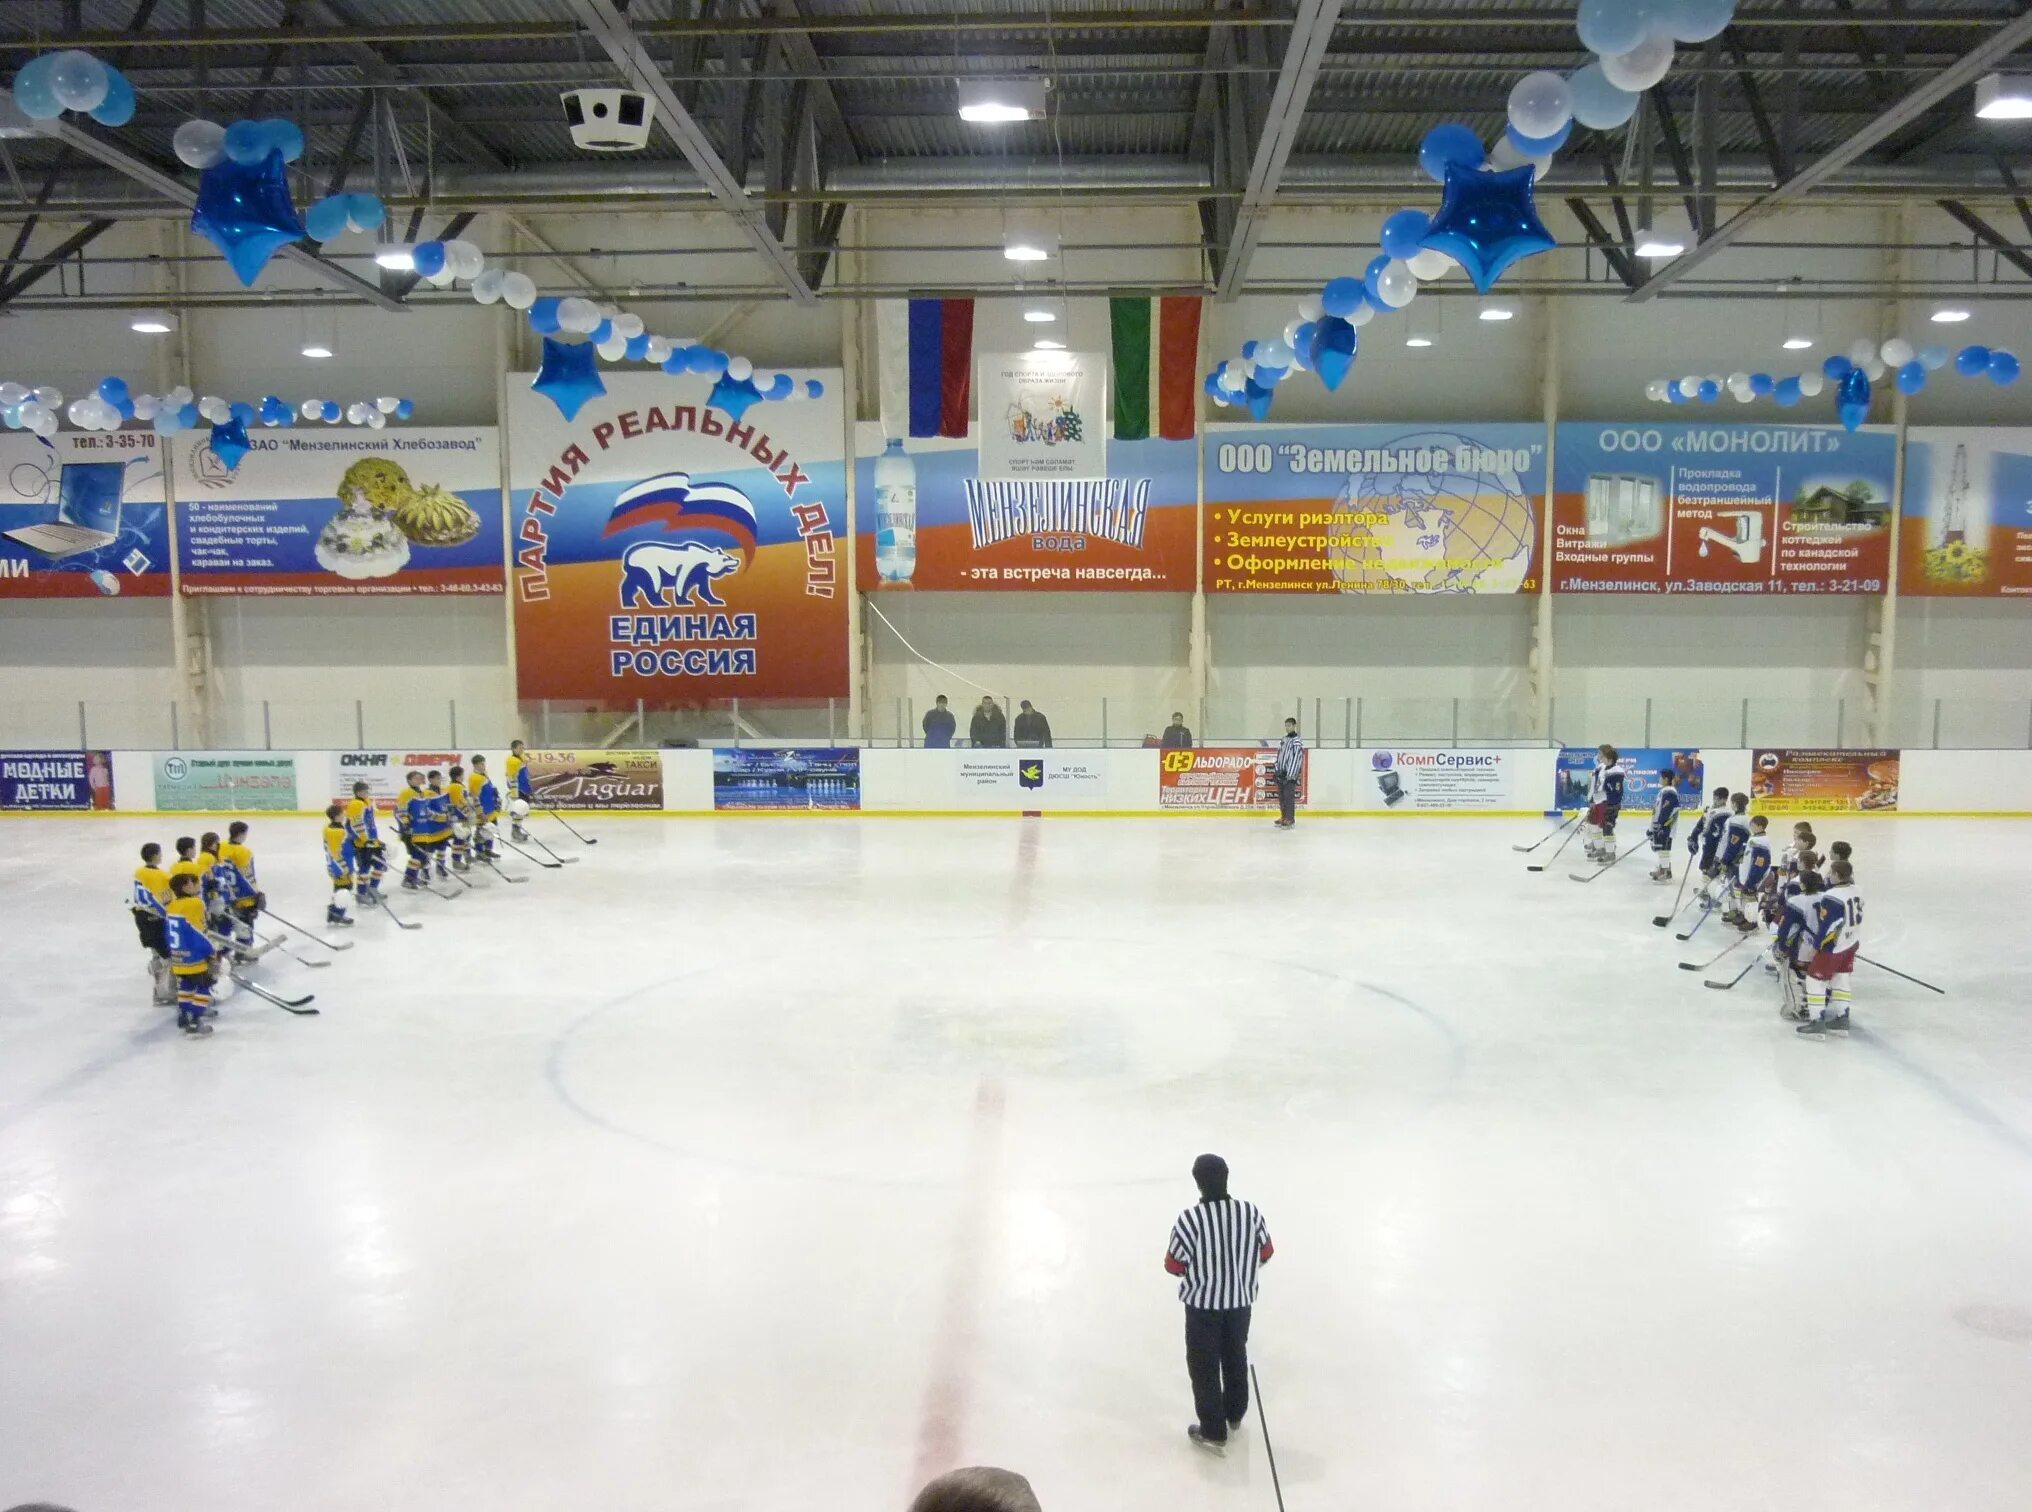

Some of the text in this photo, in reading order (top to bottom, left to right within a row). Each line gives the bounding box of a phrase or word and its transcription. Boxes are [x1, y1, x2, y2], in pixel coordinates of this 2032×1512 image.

[73, 434, 156, 449] тел.: 3-35-70
[250, 438, 280, 452] ЗАО
[1599, 430, 1840, 453] ООО «МОНОЛИТ»
[592, 405, 811, 498] РЕАЛЬНЫХ
[1218, 444, 1273, 474] ООО
[1679, 467, 1742, 482] Прокладка
[1678, 482, 1757, 493] водопровода
[188, 502, 200, 512] 50
[207, 502, 279, 512] наименований
[1677, 494, 1772, 506] безтраншейный
[189, 513, 265, 524] хлебобулочных
[963, 478, 1153, 551] МЕНЗЕЛИНСКАЯ
[1228, 508, 1390, 528] Услуги риэлтора
[1677, 508, 1713, 519] метод
[519, 443, 591, 603] ПАРТИЯ
[1782, 521, 1872, 533] Строительство
[198, 526, 265, 537] кондитерских
[266, 525, 310, 534] изделий,
[1556, 525, 1586, 536] Окна
[190, 537, 279, 546] свадебные торты,
[1032, 534, 1087, 552] вода
[1556, 538, 1607, 550] Витражи
[1782, 534, 1842, 547] коттеджей
[790, 501, 836, 599] ДЕЛ!
[1781, 547, 1859, 559] по канадской
[232, 559, 244, 567] на
[246, 559, 275, 567] заказ.
[1227, 555, 1356, 571] Оформление
[1555, 551, 1654, 565] Входные группы
[1780, 561, 1847, 573] технологии
[971, 567, 998, 580] эта
[1003, 567, 1071, 583] встреча
[1075, 567, 1166, 583] навсегда...
[182, 584, 236, 594] Приглашаем
[244, 585, 312, 595] сотрудничеству
[314, 585, 356, 595] торговые
[357, 584, 412, 594] организации
[1216, 579, 1235, 591] РТ,
[1238, 578, 1314, 590] г.Мензелинск
[1315, 578, 1373, 590] ул.Ленина
[1560, 579, 1880, 594] г.Мензелинск, ул.Заводская 11, тел.: 3-21-09
[609, 613, 757, 646] ЕДИНАЯ
[611, 648, 757, 676] РОССИЯ
[341, 754, 388, 767] ОКНА
[624, 760, 657, 769] ТАКСИ
[1396, 752, 1502, 768] КомпСервис+
[3, 762, 86, 782] МОДНЫЕ
[1072, 766, 1087, 774] ДОД
[15, 783, 76, 803] ДЕТКИ
[575, 776, 659, 801] Jaguar
[1160, 793, 1206, 804] НИЗКИХ
[1206, 787, 1251, 806] ЦЕН
[168, 919, 180, 949] 5
